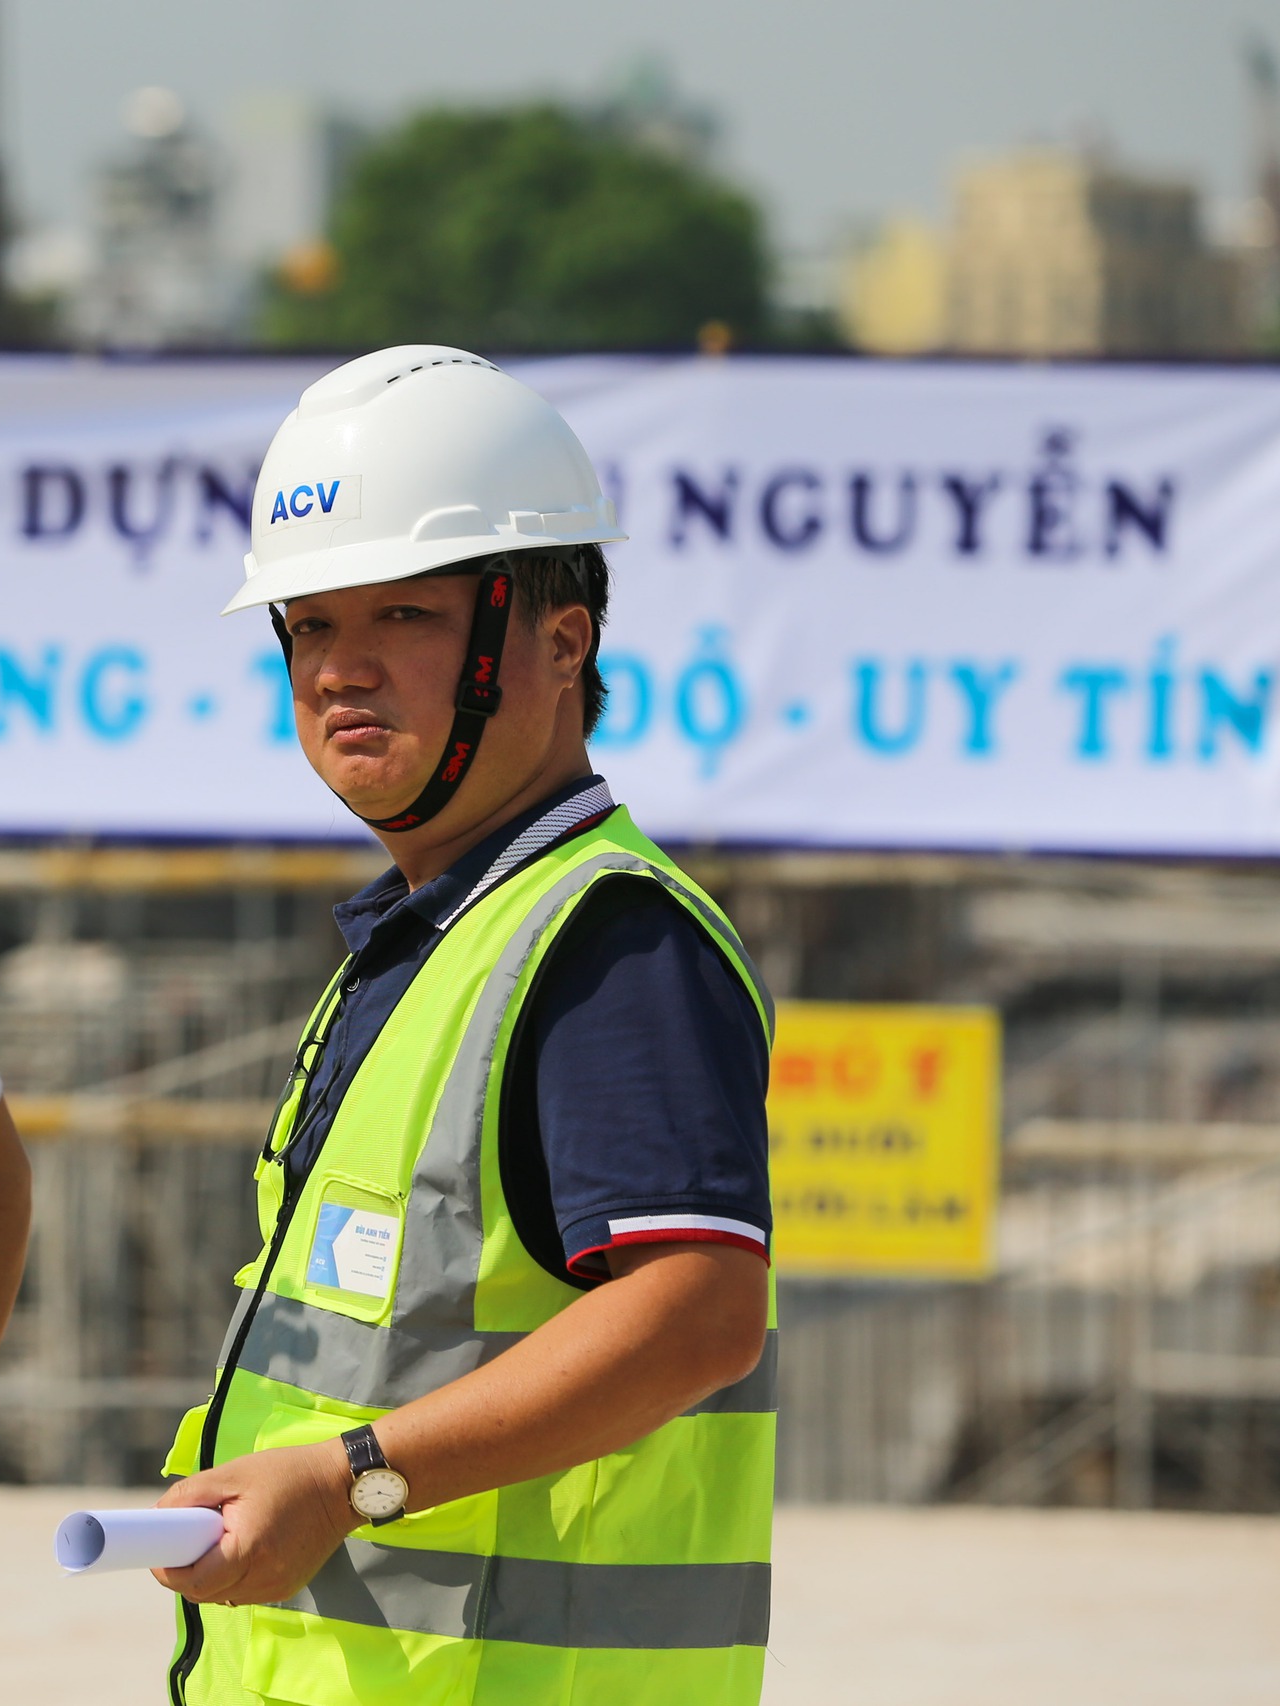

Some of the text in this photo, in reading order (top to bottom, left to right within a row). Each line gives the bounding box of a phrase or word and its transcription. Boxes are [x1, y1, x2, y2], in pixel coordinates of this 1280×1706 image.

[21, 452, 253, 570] DỰN
[669, 426, 1177, 558] NGUYỄN
[270, 480, 341, 525] ACV
[852, 659, 1018, 758] UY
[1060, 633, 1276, 763] TÍN
[441, 742, 471, 783] 3M
